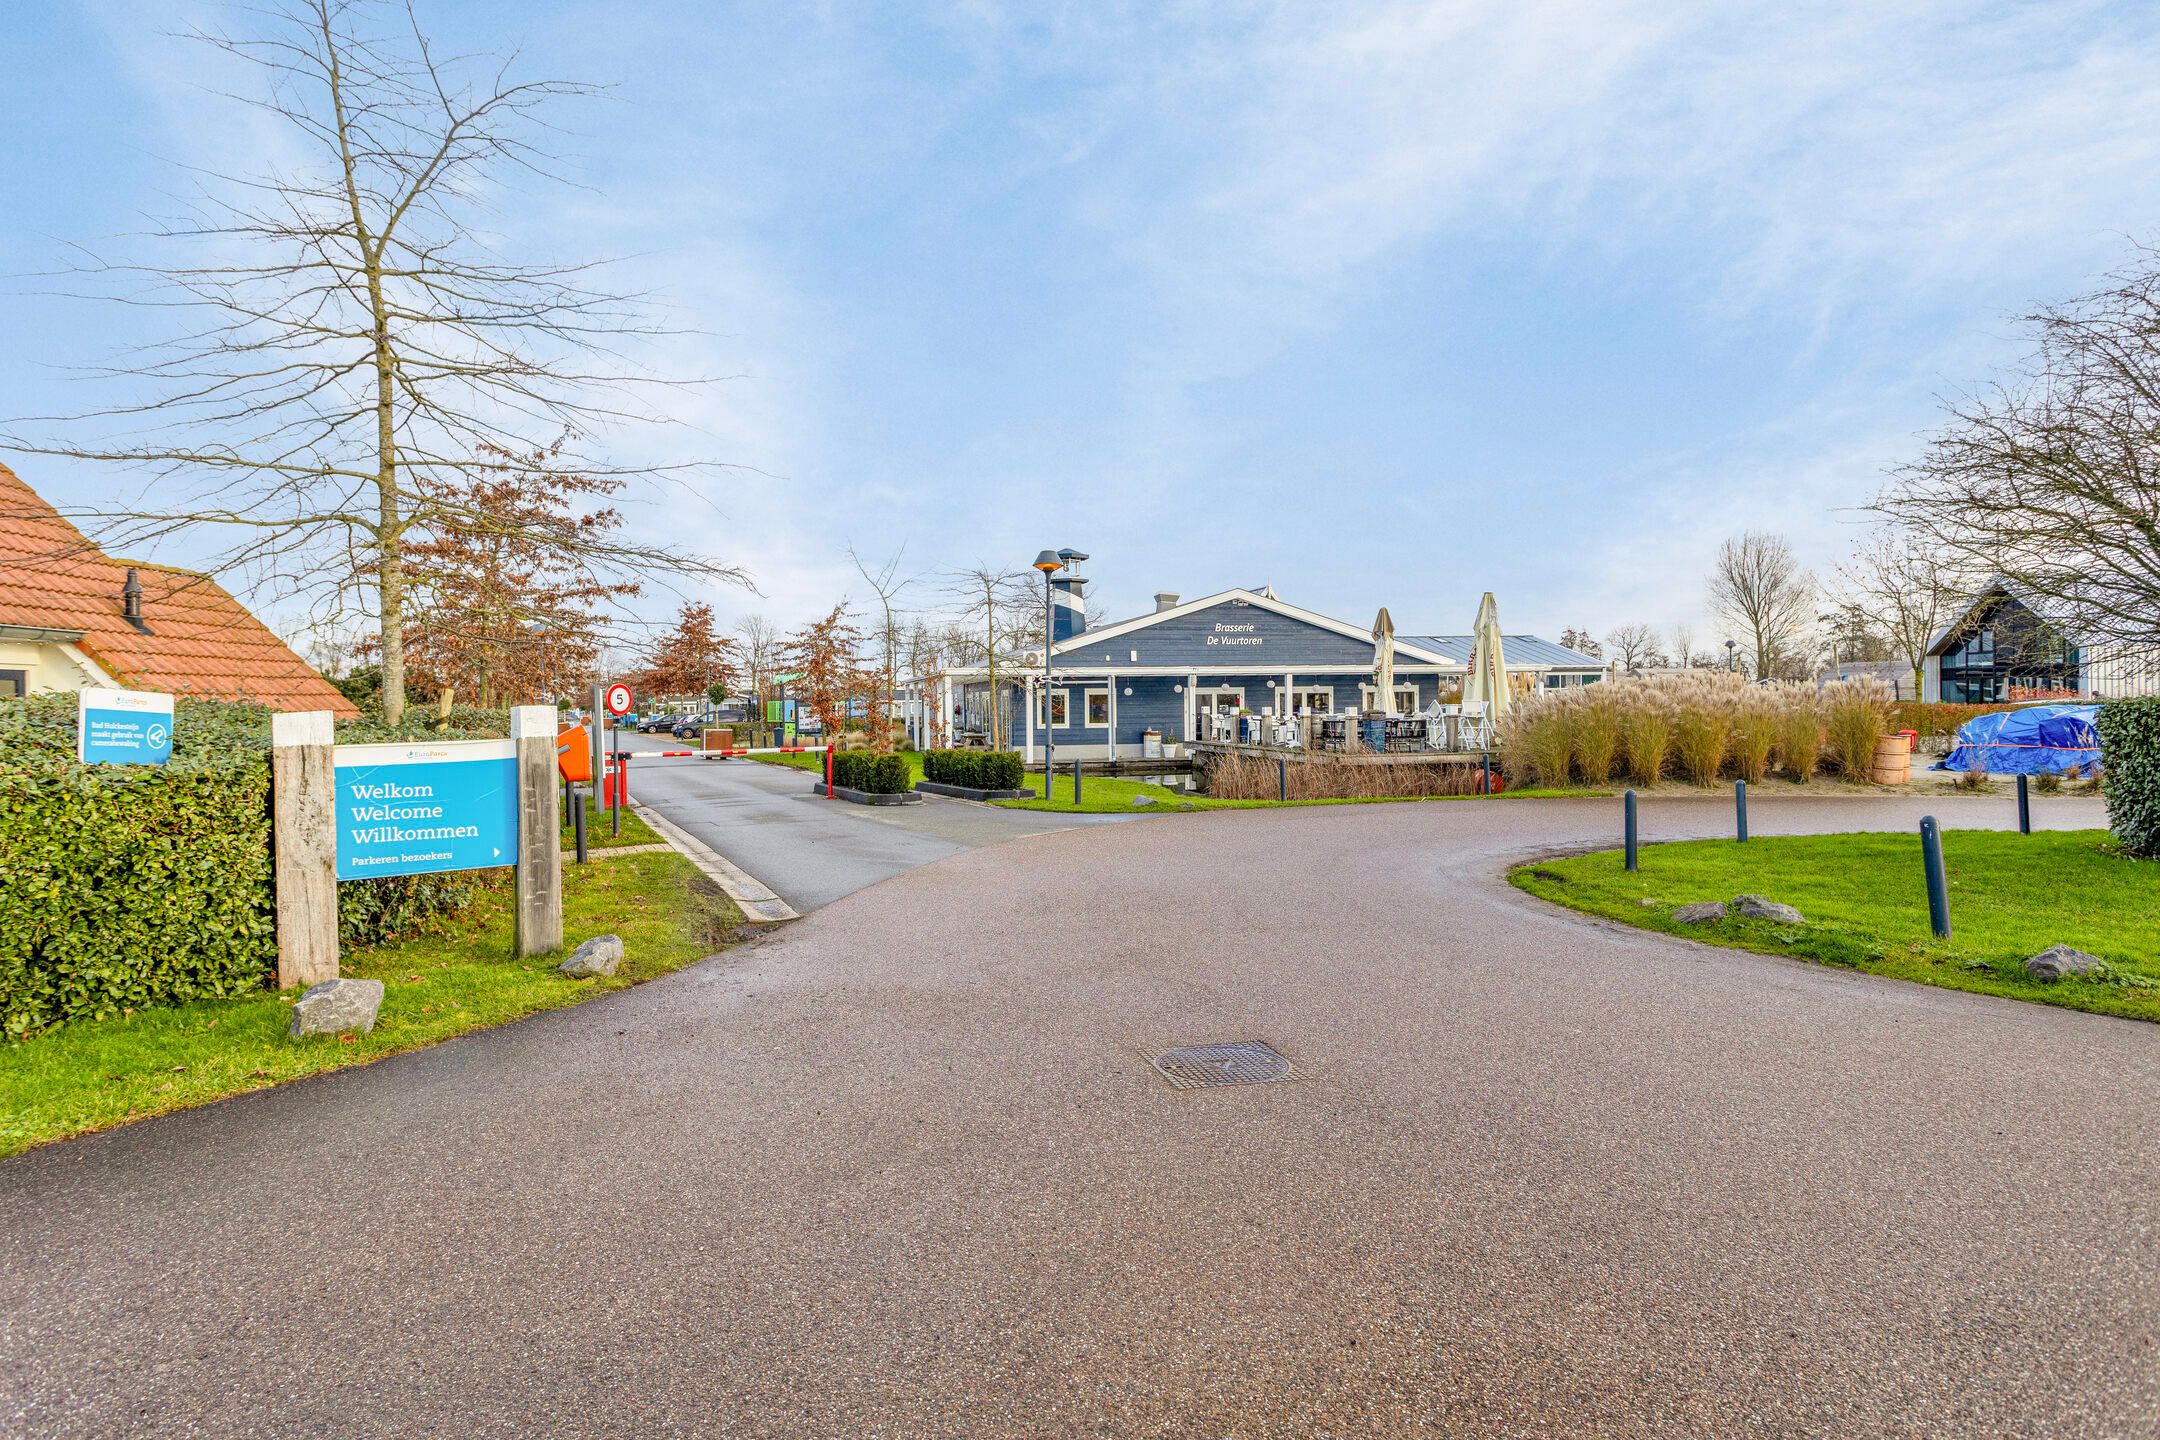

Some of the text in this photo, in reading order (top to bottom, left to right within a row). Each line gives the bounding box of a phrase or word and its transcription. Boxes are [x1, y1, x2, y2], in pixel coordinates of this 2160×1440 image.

[1215, 623, 1254, 632] Brasserie
[1207, 636, 1263, 645] De Vuurtoren
[616, 694, 624, 705] 5
[91, 721, 104, 729] Bad
[111, 731, 133, 740] gebruik
[91, 740, 139, 748] camerabewaking
[352, 783, 433, 799] Welkom
[351, 805, 443, 822] Welcome
[352, 825, 479, 844] Willkommen
[352, 851, 453, 866] Parkeren bezoekers
